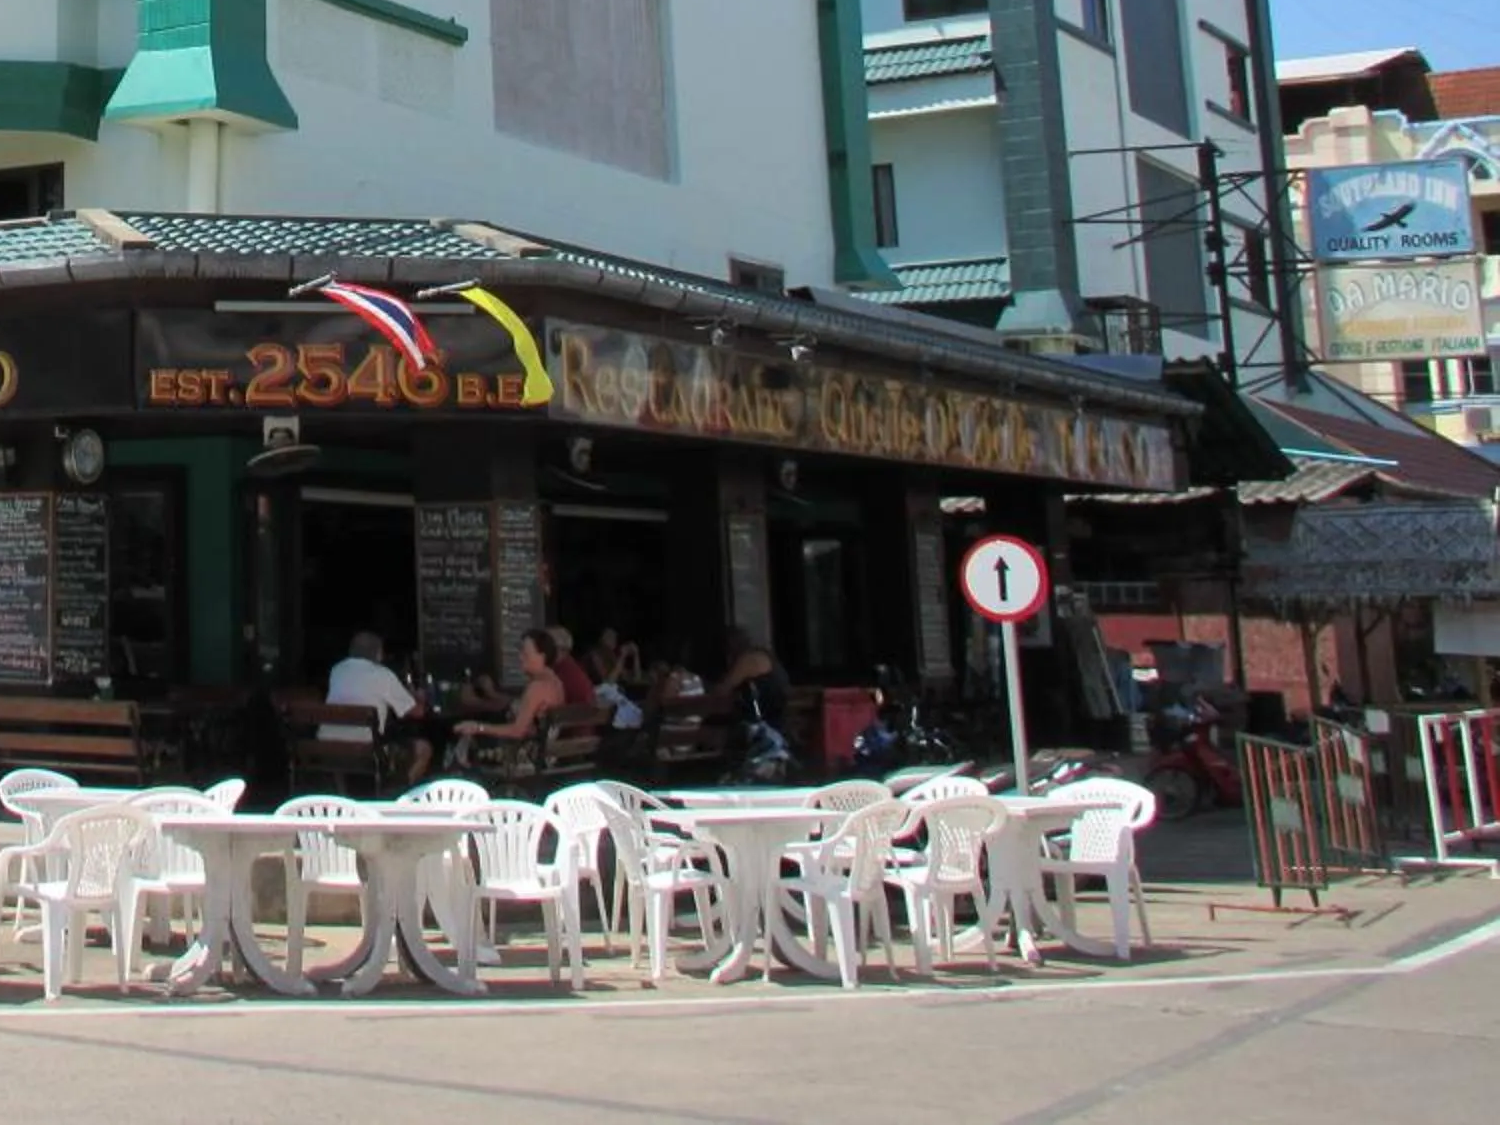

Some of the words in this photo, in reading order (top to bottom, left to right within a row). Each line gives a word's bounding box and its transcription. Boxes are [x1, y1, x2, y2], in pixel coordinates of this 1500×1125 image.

[1328, 235, 1389, 252] QUALITY
[1401, 231, 1459, 248] ROOMS
[1328, 281, 1365, 315] DA
[1373, 271, 1472, 310] MARIO
[245, 342, 450, 408] 2546
